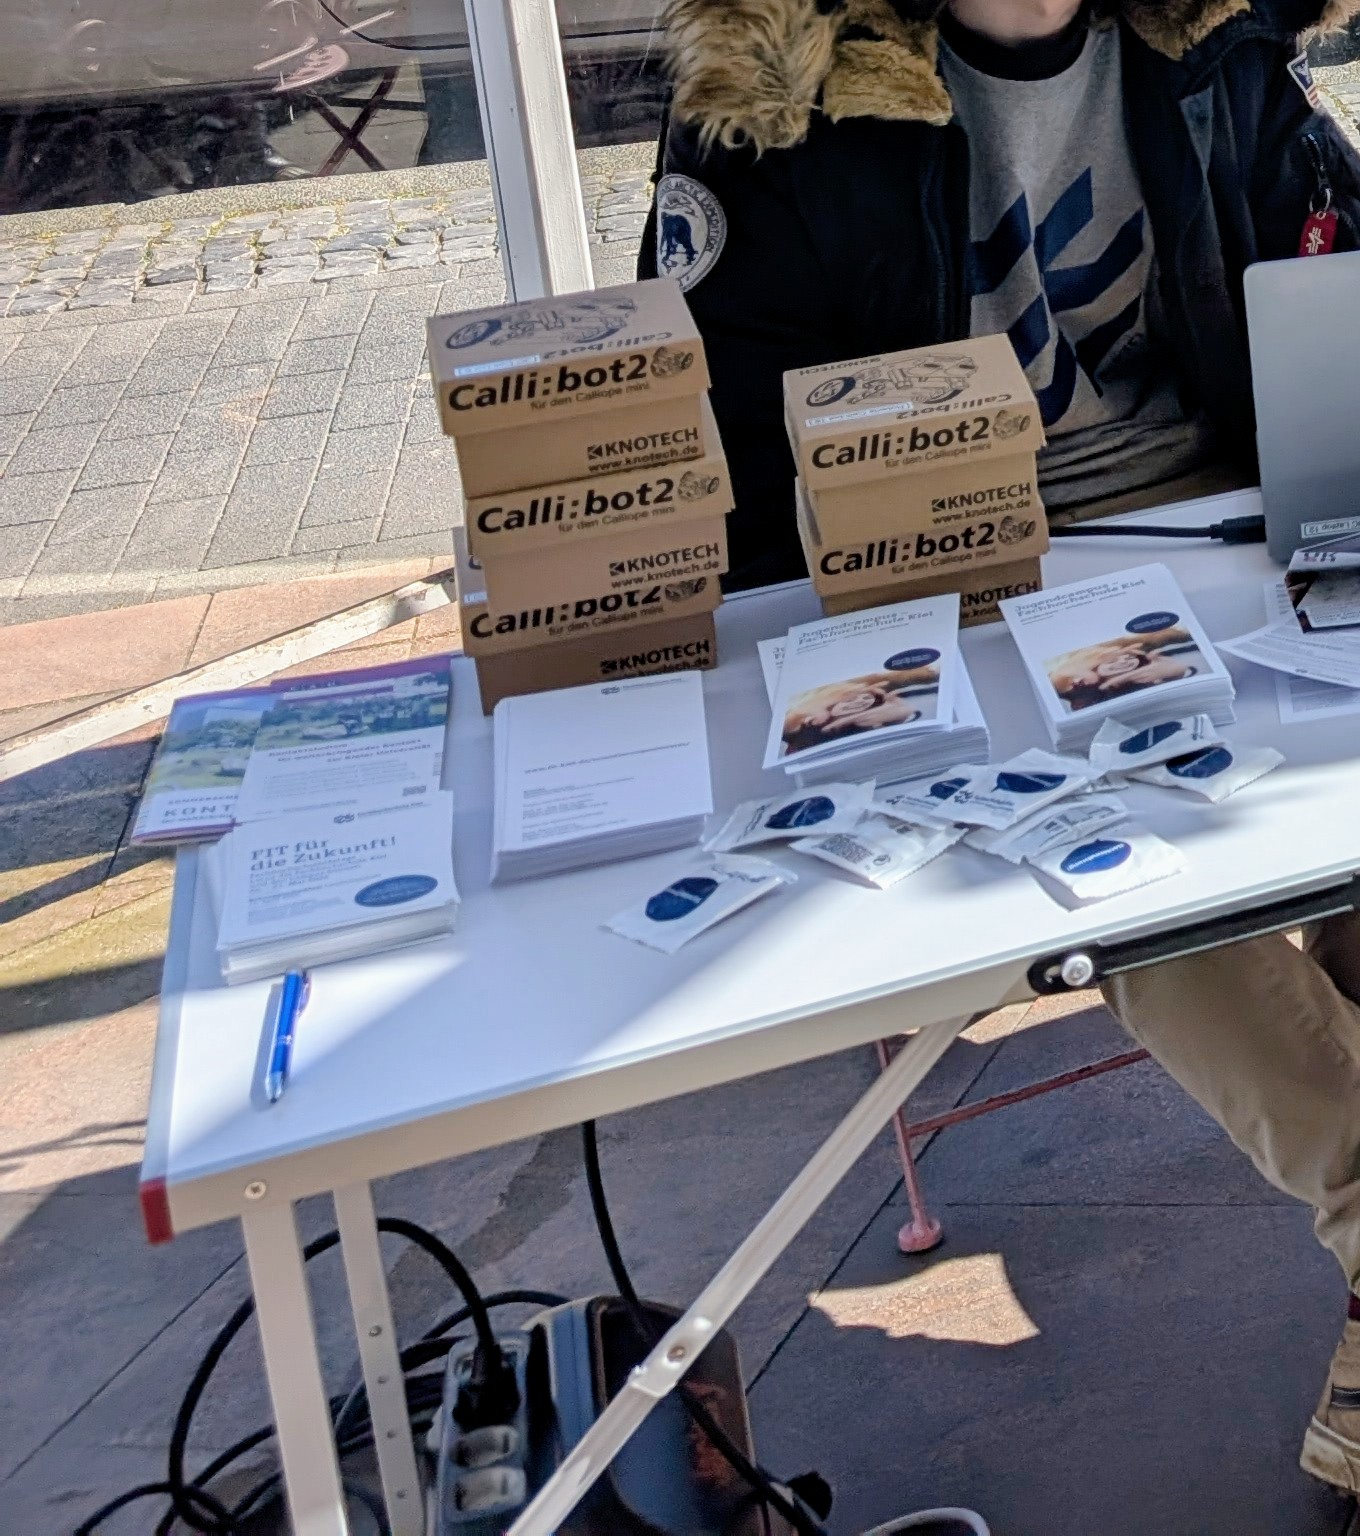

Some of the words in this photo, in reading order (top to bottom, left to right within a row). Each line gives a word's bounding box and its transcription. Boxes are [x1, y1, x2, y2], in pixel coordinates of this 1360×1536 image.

[449, 354, 647, 411] Calli:bot2
[530, 400, 548, 411] für
[550, 395, 572, 407] den
[576, 386, 622, 402] Calliope
[626, 381, 650, 393] mini
[606, 427, 698, 457] KNOTECH
[812, 417, 989, 469] Calli:bot2
[885, 459, 900, 469] für
[902, 454, 922, 466] den
[925, 446, 967, 462] Calliope
[970, 441, 992, 453] mini
[588, 445, 698, 473] www.knotech.de
[477, 478, 673, 534] Calli:bot2
[948, 482, 1031, 510] KNOTECH
[558, 521, 573, 533] für
[576, 518, 598, 530] den
[602, 510, 648, 526] Calliope
[652, 504, 675, 516] mini
[932, 499, 1031, 524] www.knotech.de
[628, 543, 719, 573] KNOTECH
[820, 522, 994, 575] Calli:bot2
[908, 560, 928, 571] den
[931, 552, 972, 568] Calliope
[611, 560, 719, 589] www.knotech.de
[567, 620, 590, 632] den
[619, 640, 709, 672] KNOTECH
[250, 858, 287, 872] die
[293, 836, 396, 865] Zukunft!
[251, 845, 288, 861] FIT
[294, 838, 328, 853] für
